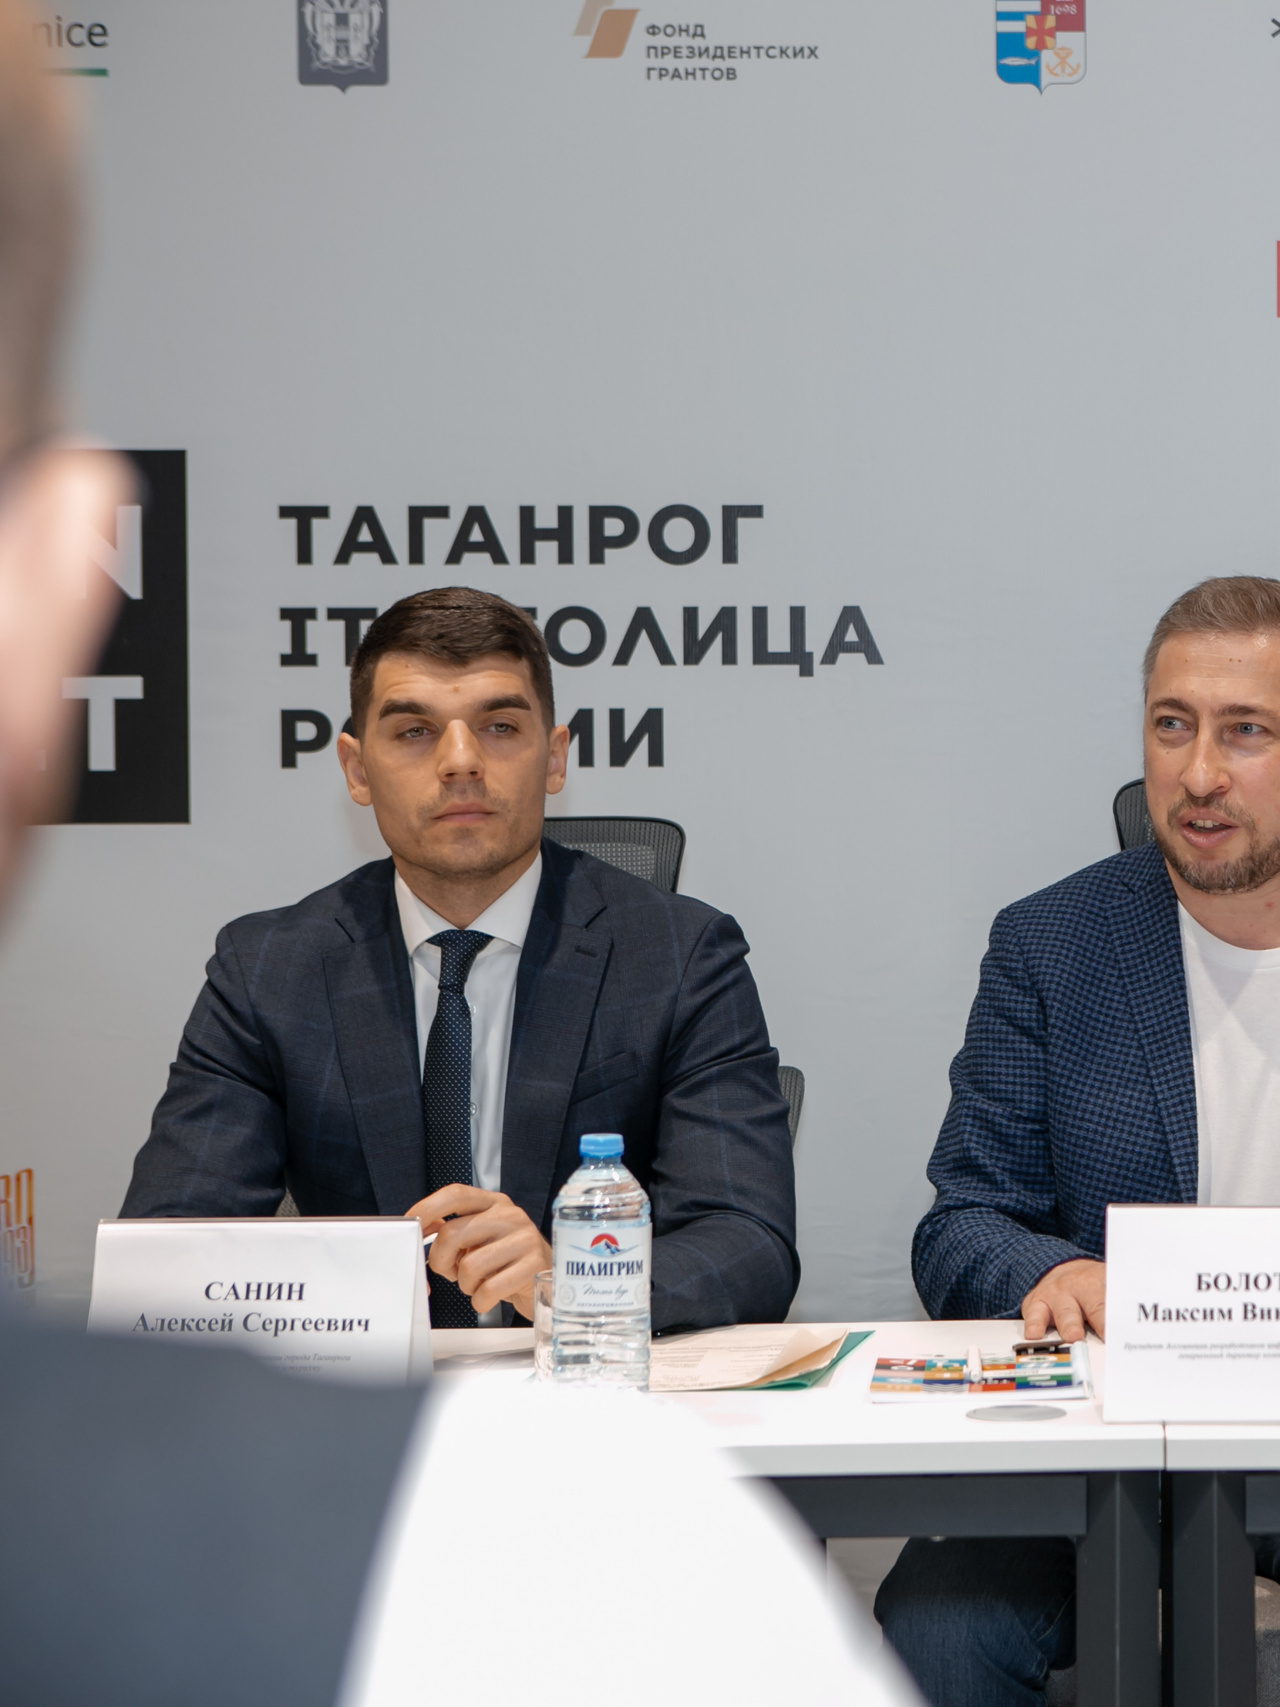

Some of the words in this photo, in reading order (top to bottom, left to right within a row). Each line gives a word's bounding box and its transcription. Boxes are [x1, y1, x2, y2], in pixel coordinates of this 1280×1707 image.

[646, 24, 706, 40] ФОНД
[646, 46, 819, 61] ПРЕЗИДЕНТСКИХ
[646, 67, 737, 81] ГРАНТОВ
[279, 504, 764, 566] ТАГАНРОГ
[566, 1260, 644, 1276] ПИЛИГРИМ
[204, 1281, 306, 1301] САНИН
[1137, 1302, 1233, 1322] Максим
[132, 1312, 234, 1332] Алексей
[242, 1312, 371, 1337] Сергеевич
